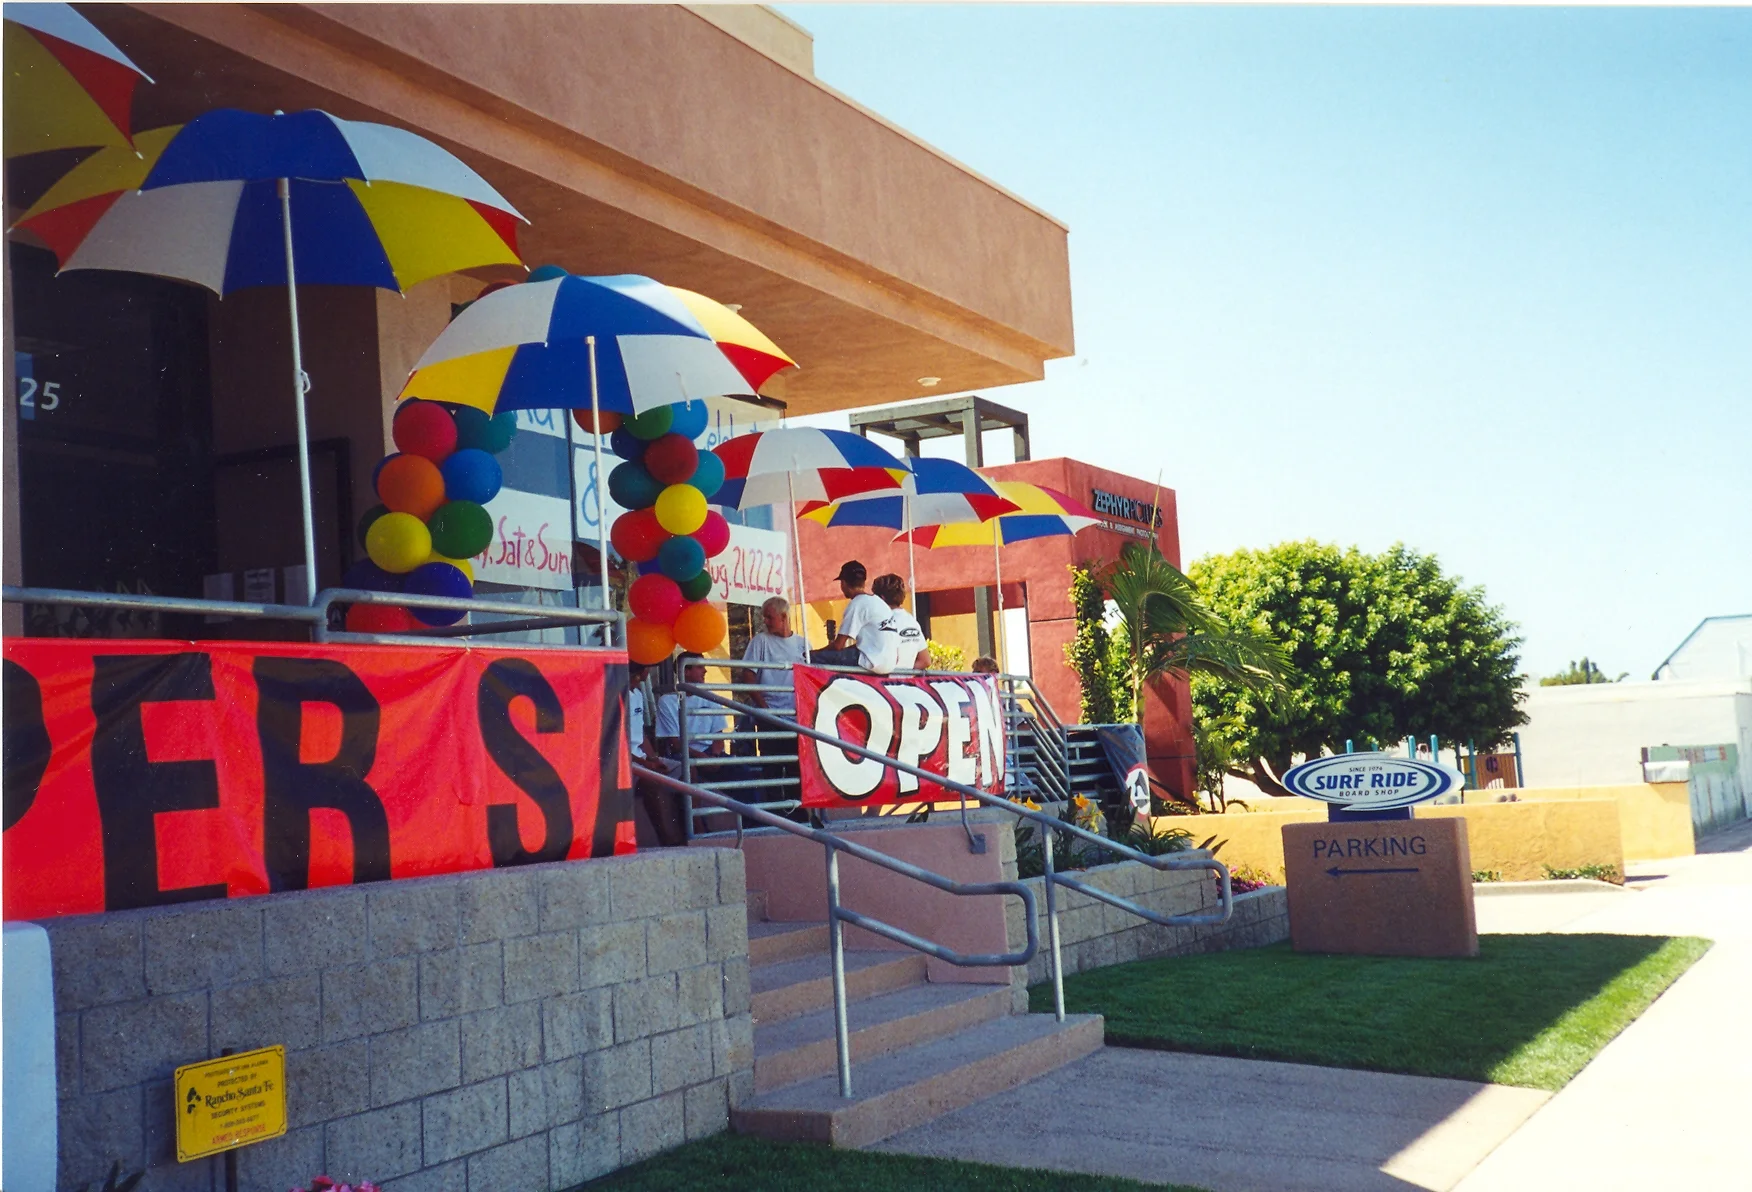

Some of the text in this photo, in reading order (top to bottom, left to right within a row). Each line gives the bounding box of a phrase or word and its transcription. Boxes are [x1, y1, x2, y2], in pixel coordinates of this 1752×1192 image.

[20, 377, 60, 410] 25
[815, 678, 1005, 798] OPEN
[1314, 771, 1418, 790] SURF RIDE
[1339, 788, 1400, 797] BOARD SHOP
[1313, 836, 1427, 859] PARKING
[205, 1080, 275, 1109] Rancho Santa Fe
